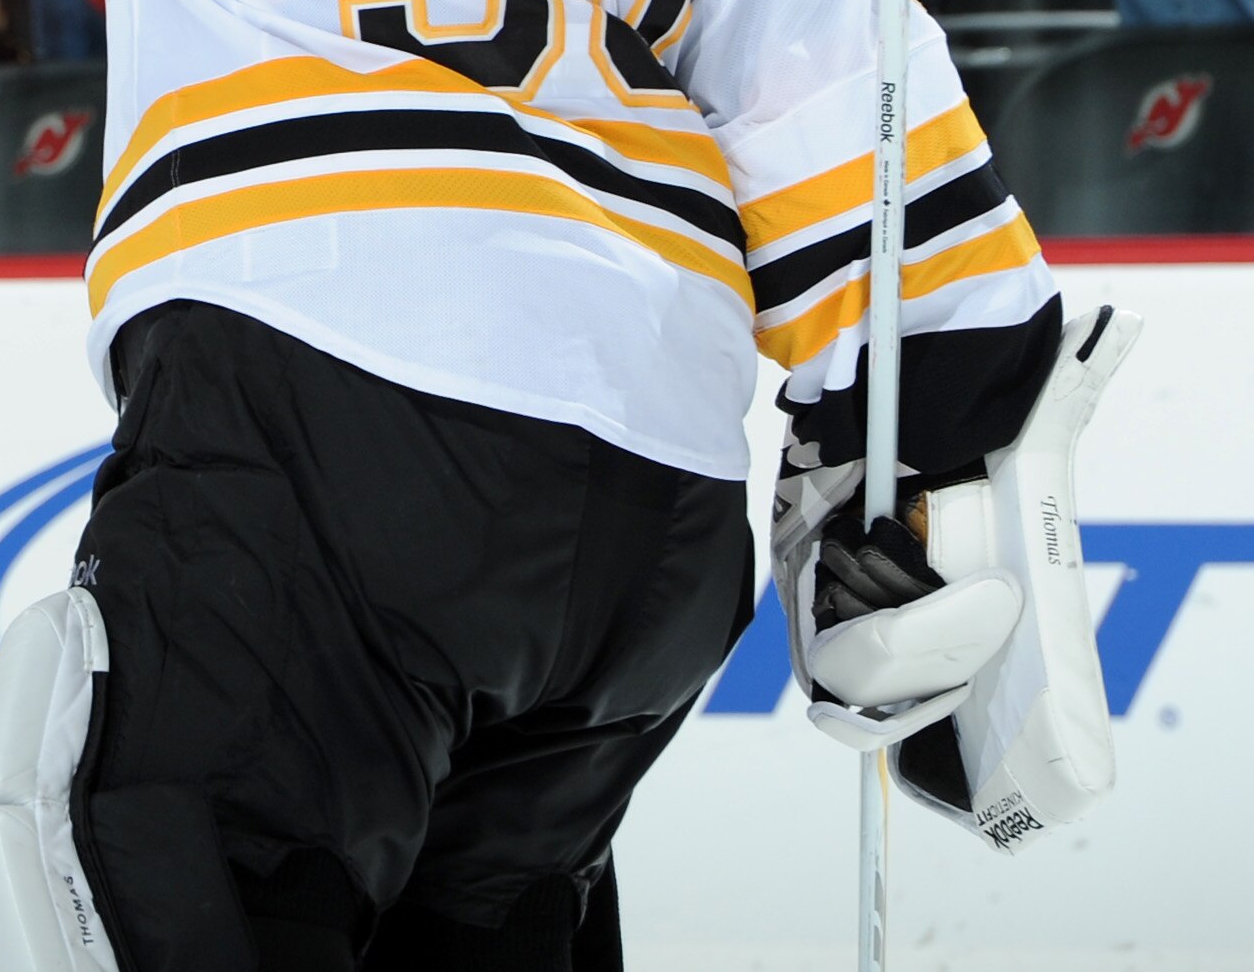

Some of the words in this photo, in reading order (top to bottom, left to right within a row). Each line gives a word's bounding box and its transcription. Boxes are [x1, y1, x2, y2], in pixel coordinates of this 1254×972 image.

[880, 81, 896, 143] Reebok
[1040, 495, 1062, 566] Thomas
[983, 806, 1045, 857] Reebok
[63, 875, 95, 946] THOMAS
